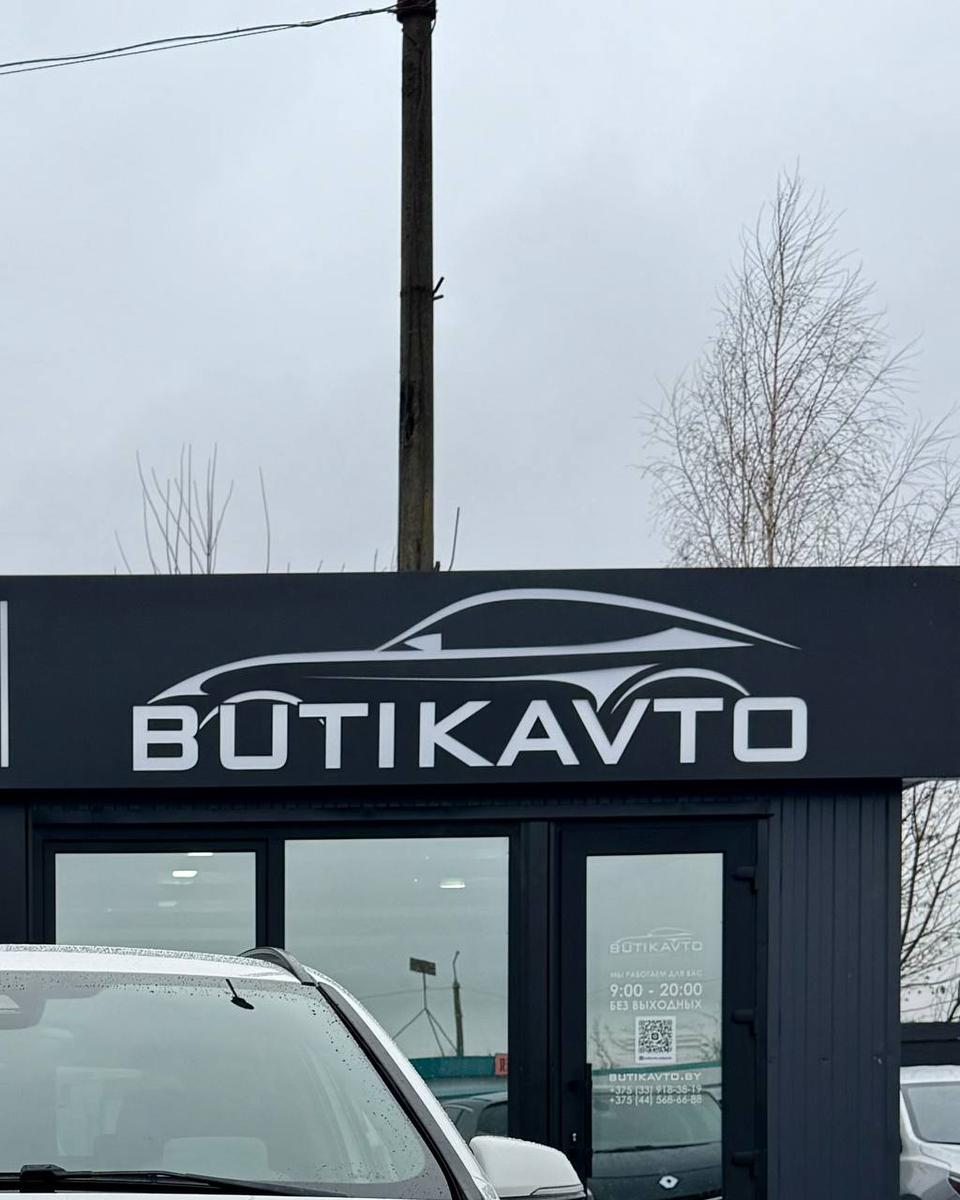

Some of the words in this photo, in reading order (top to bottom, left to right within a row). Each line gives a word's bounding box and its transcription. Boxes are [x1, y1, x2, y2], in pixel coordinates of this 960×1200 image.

[132, 695, 809, 772] BUTIKAVTO
[609, 941, 703, 953] BUTIKAVTO
[610, 983, 642, 998] 9:00
[660, 982, 702, 997] 20:00
[610, 1000, 629, 1011] БЕЗ
[632, 999, 702, 1011] ВЫХОДНЫХ
[609, 1072, 702, 1081] BUTIKAVTO.BY
